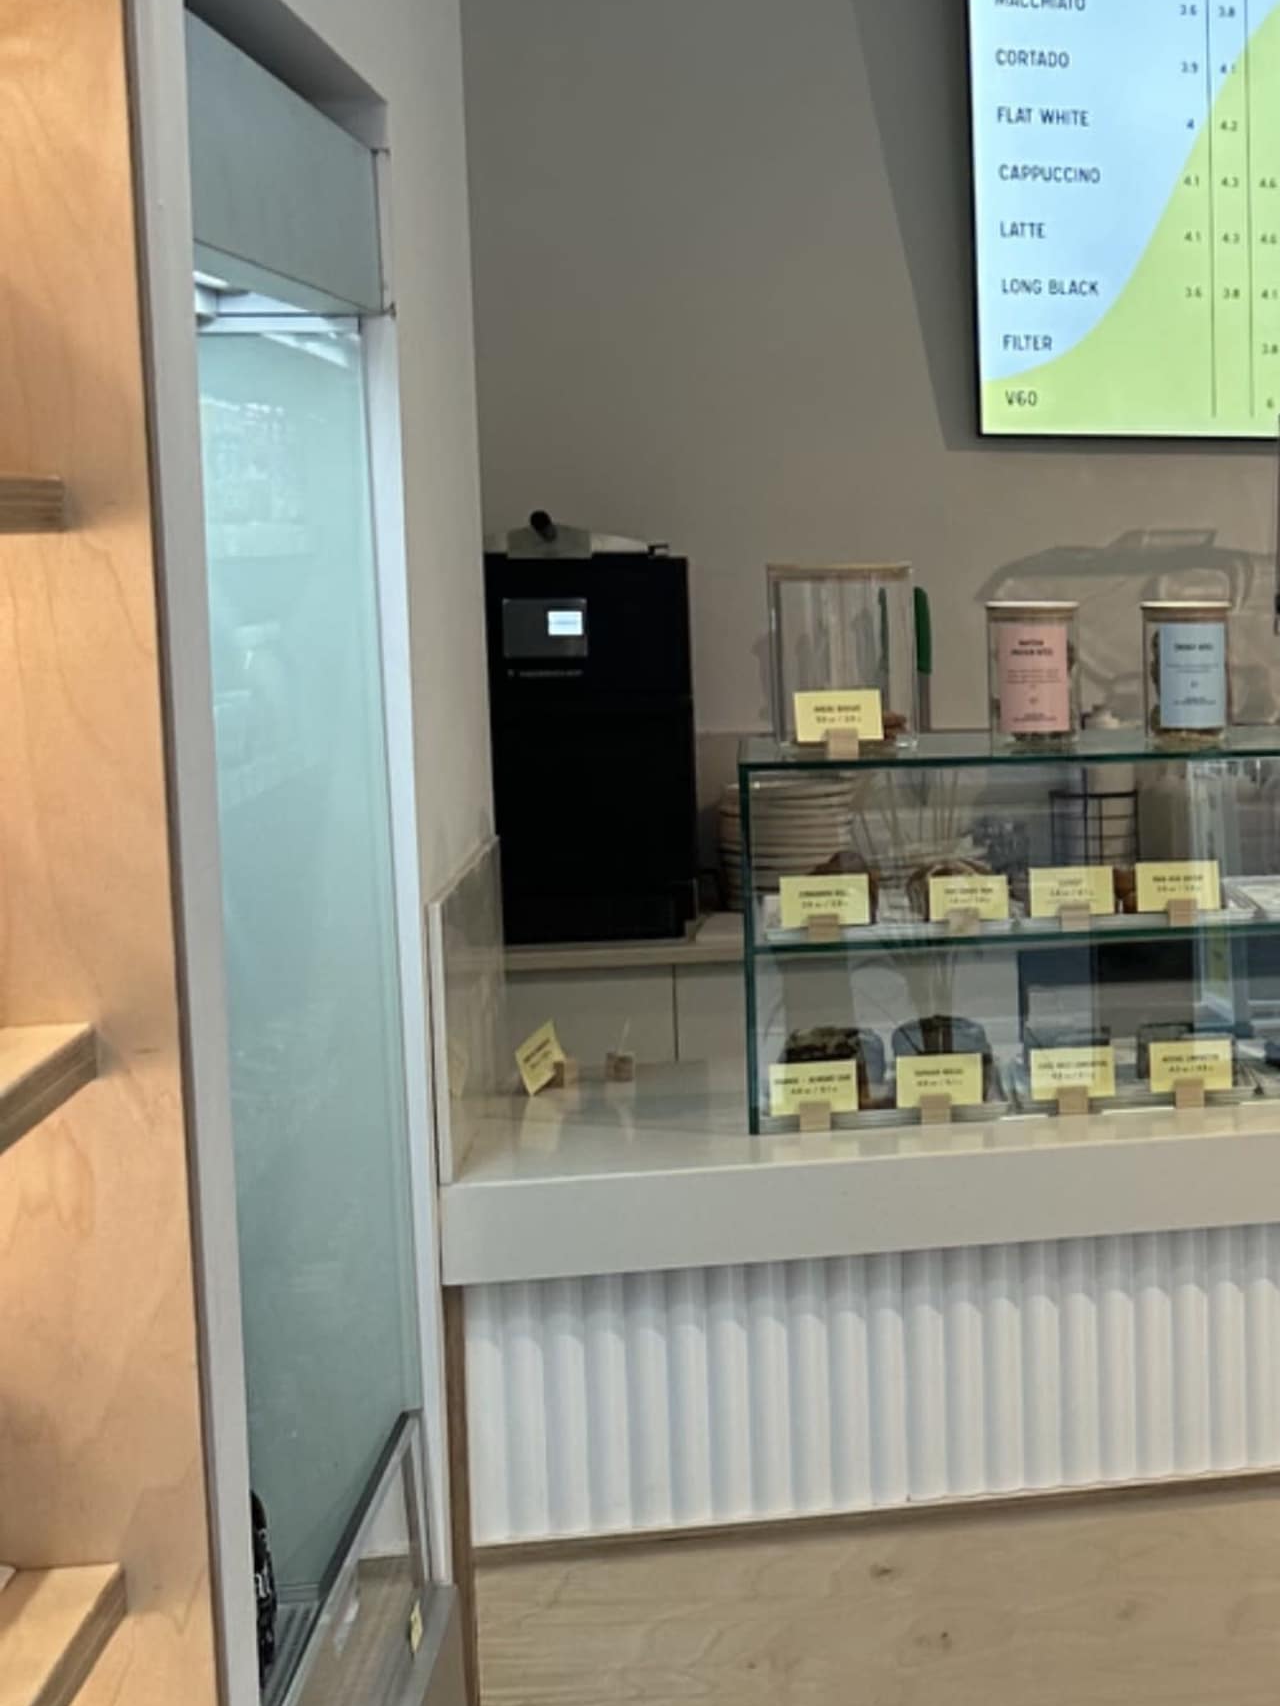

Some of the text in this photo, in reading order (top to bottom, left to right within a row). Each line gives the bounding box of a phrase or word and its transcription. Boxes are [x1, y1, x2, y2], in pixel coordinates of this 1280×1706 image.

[995, 49, 1070, 68] CORTADO
[998, 106, 1032, 124] FLAT
[1040, 109, 1089, 127] WHITE
[999, 165, 1100, 184] CAPPUCCINO
[1001, 222, 1046, 238] LATTE
[1002, 279, 1042, 294] LONG
[1048, 280, 1099, 296] BLACK
[1004, 335, 1052, 351] FILTER
[1005, 390, 1037, 407] V60
